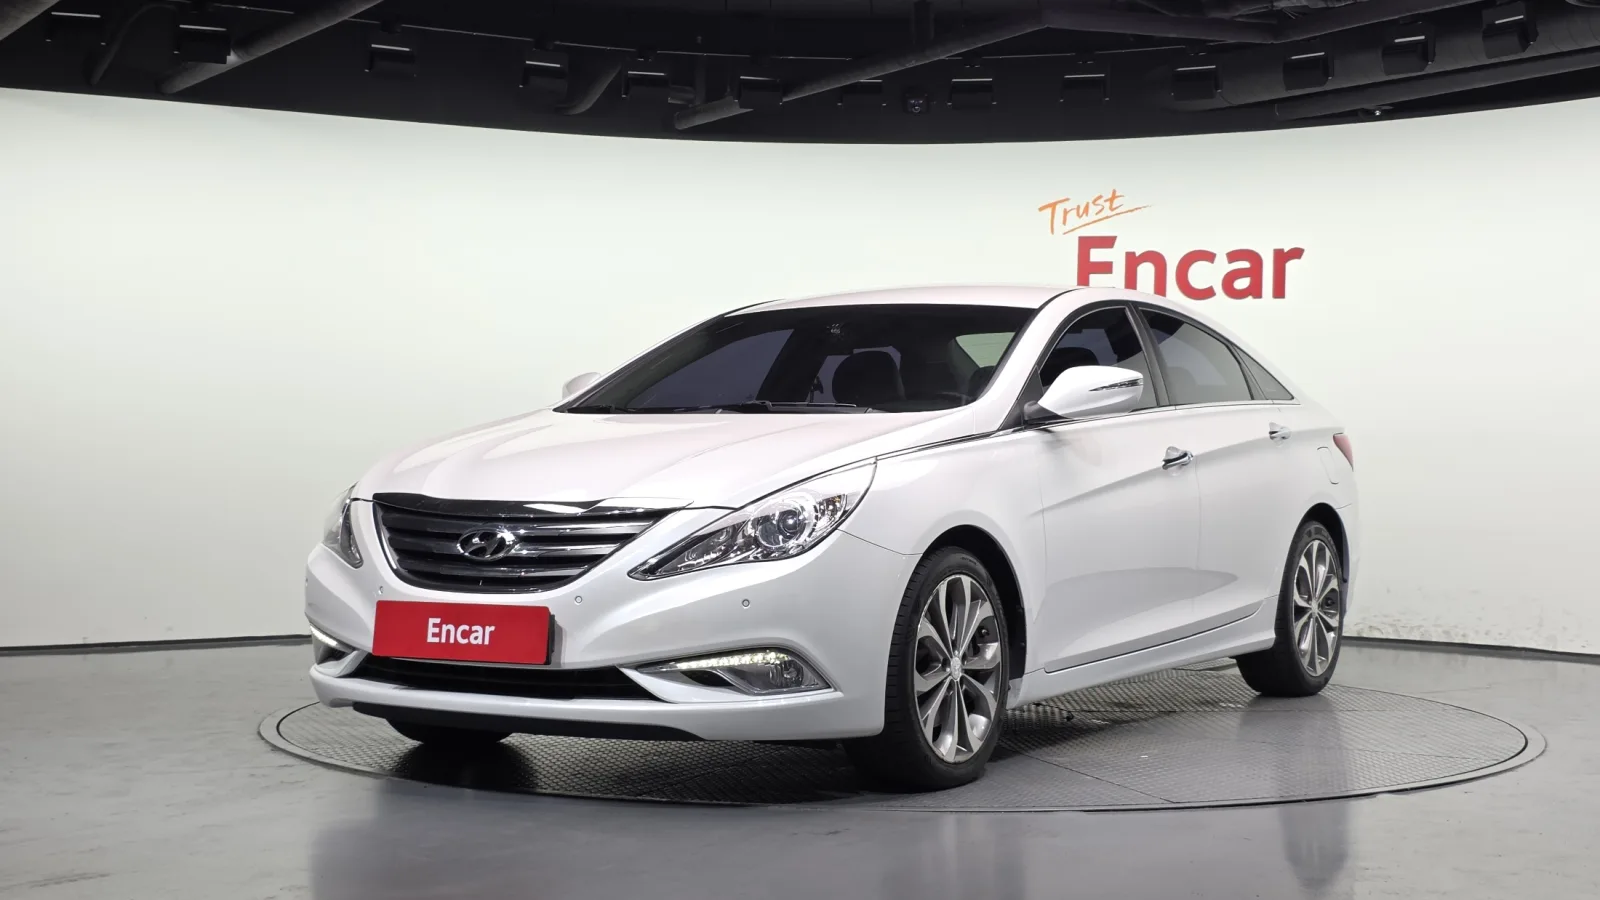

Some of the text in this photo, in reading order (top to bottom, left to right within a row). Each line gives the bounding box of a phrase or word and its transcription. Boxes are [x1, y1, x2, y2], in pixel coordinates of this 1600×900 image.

[1038, 189, 1125, 235] Trust
[1077, 235, 1305, 300] Encar
[426, 617, 496, 646] Encar
